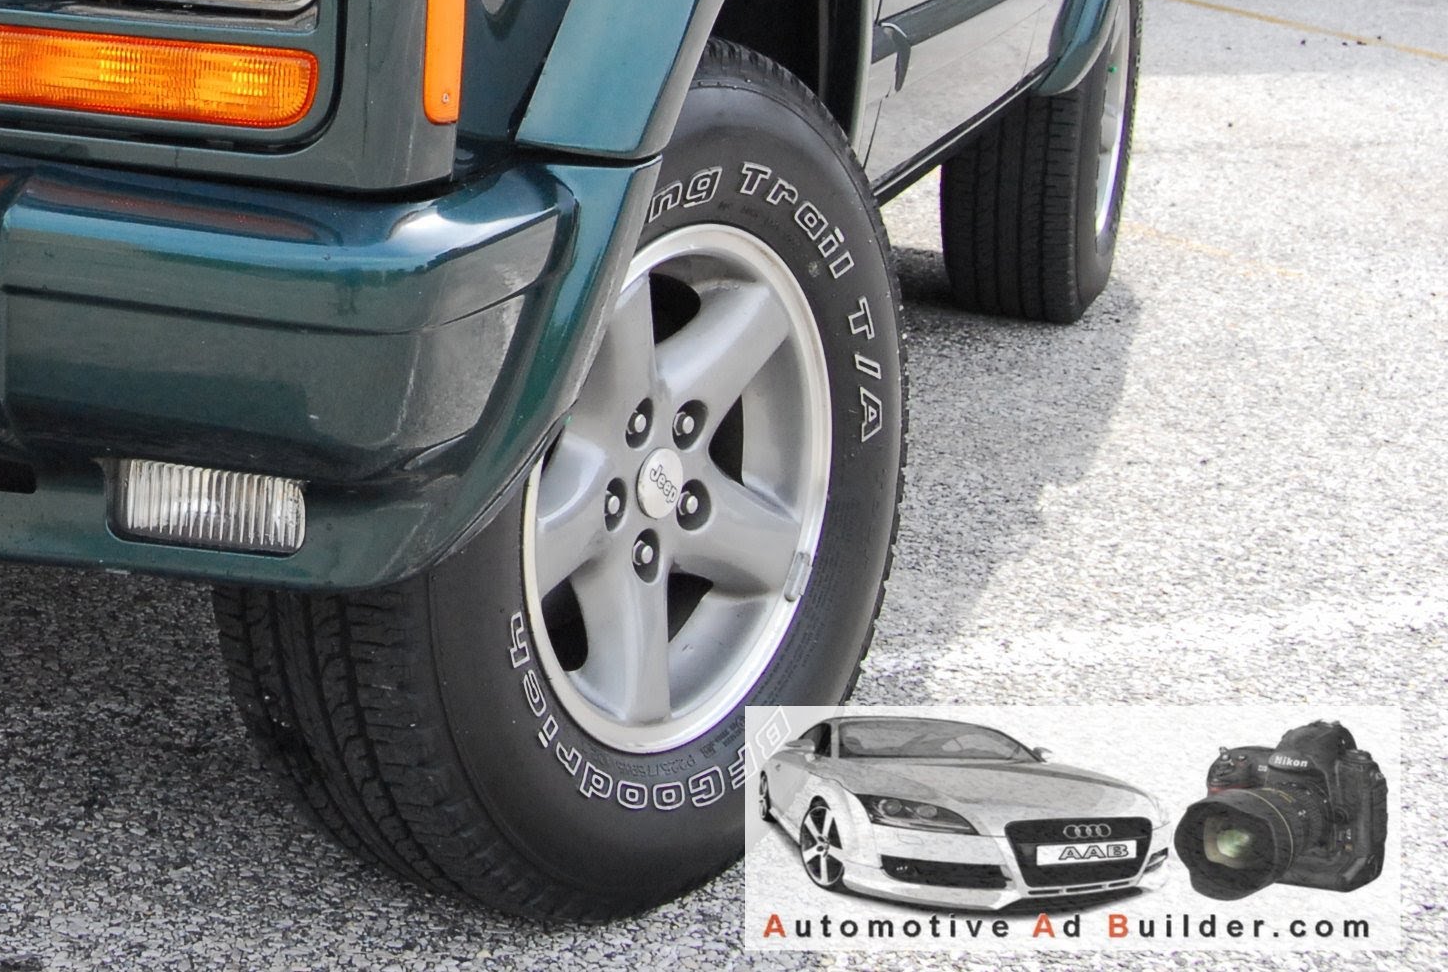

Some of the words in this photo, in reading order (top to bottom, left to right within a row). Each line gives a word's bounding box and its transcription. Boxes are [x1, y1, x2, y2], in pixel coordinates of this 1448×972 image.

[740, 161, 855, 279] Trail
[848, 295, 883, 443] T/A
[650, 464, 678, 503] Jeep
